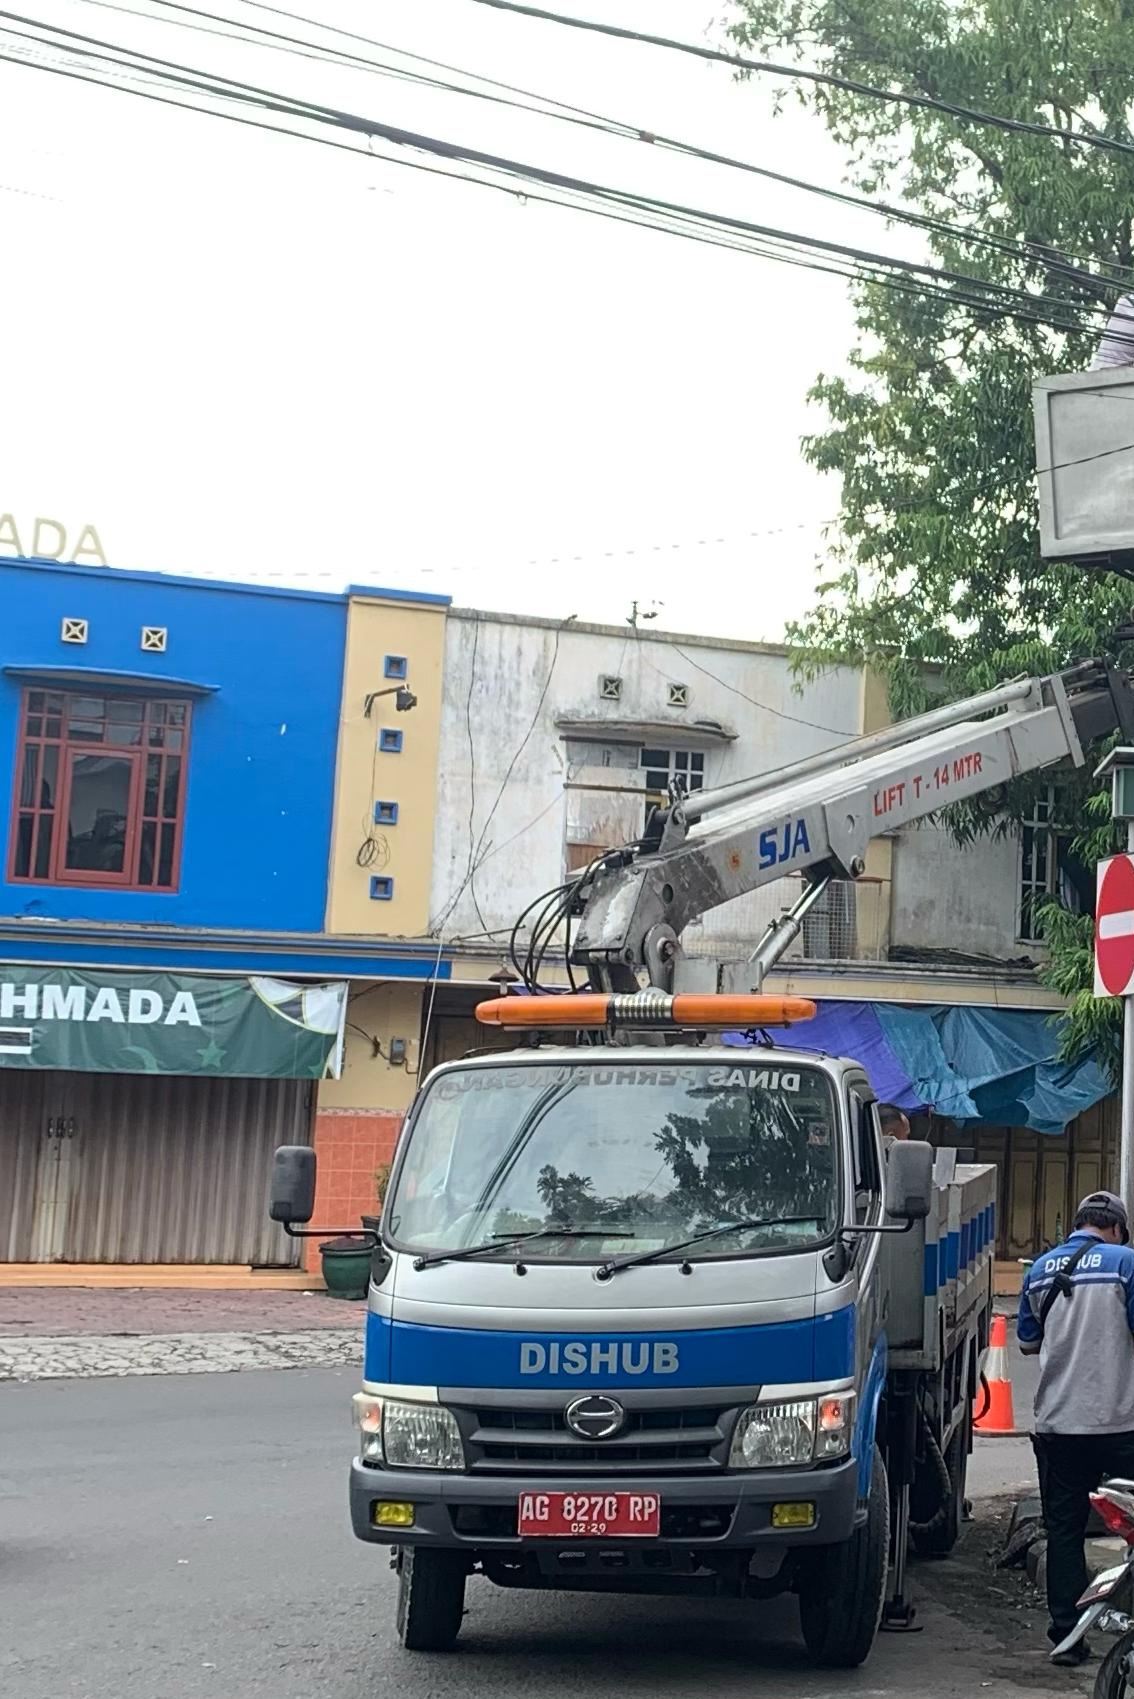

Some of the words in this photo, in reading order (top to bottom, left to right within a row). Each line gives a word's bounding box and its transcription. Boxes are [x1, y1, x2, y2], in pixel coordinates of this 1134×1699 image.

[874, 782, 906, 817] LIFT
[934, 764, 949, 791] 14
[953, 751, 983, 782] MTR
[758, 818, 811, 870] SJA
[520, 1342, 680, 1375] DISHUB
[521, 1496, 550, 1521] AG
[629, 1496, 656, 1521] RP
